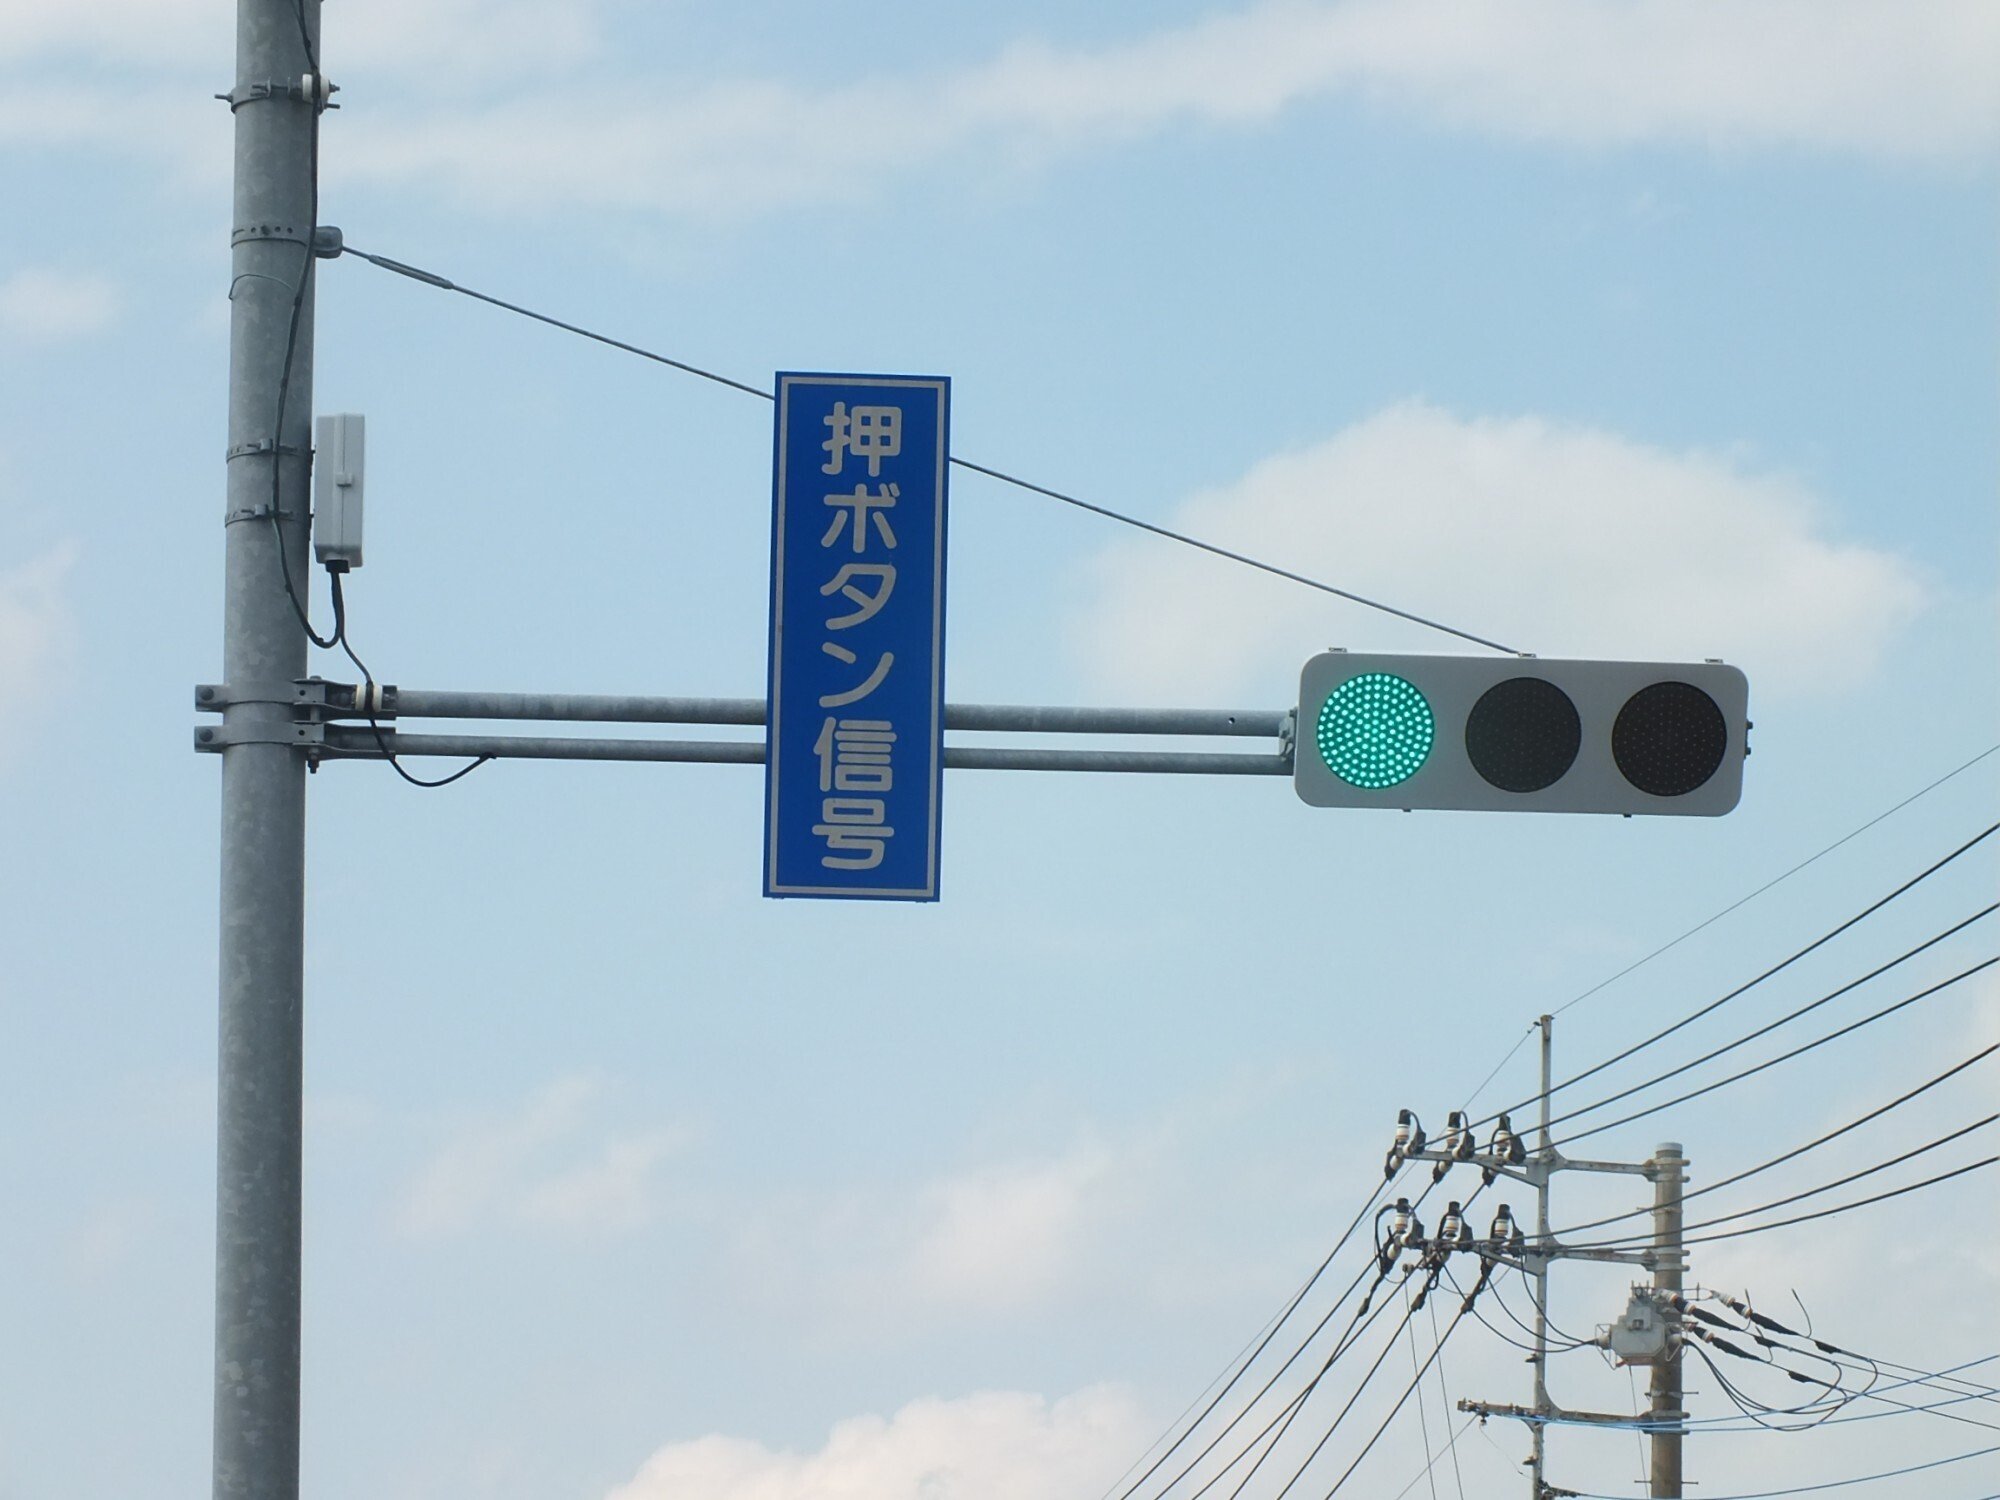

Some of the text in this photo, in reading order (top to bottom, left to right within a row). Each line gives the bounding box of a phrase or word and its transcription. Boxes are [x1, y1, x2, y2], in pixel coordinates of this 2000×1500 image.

[812, 401, 902, 870] 押ボタン信号
